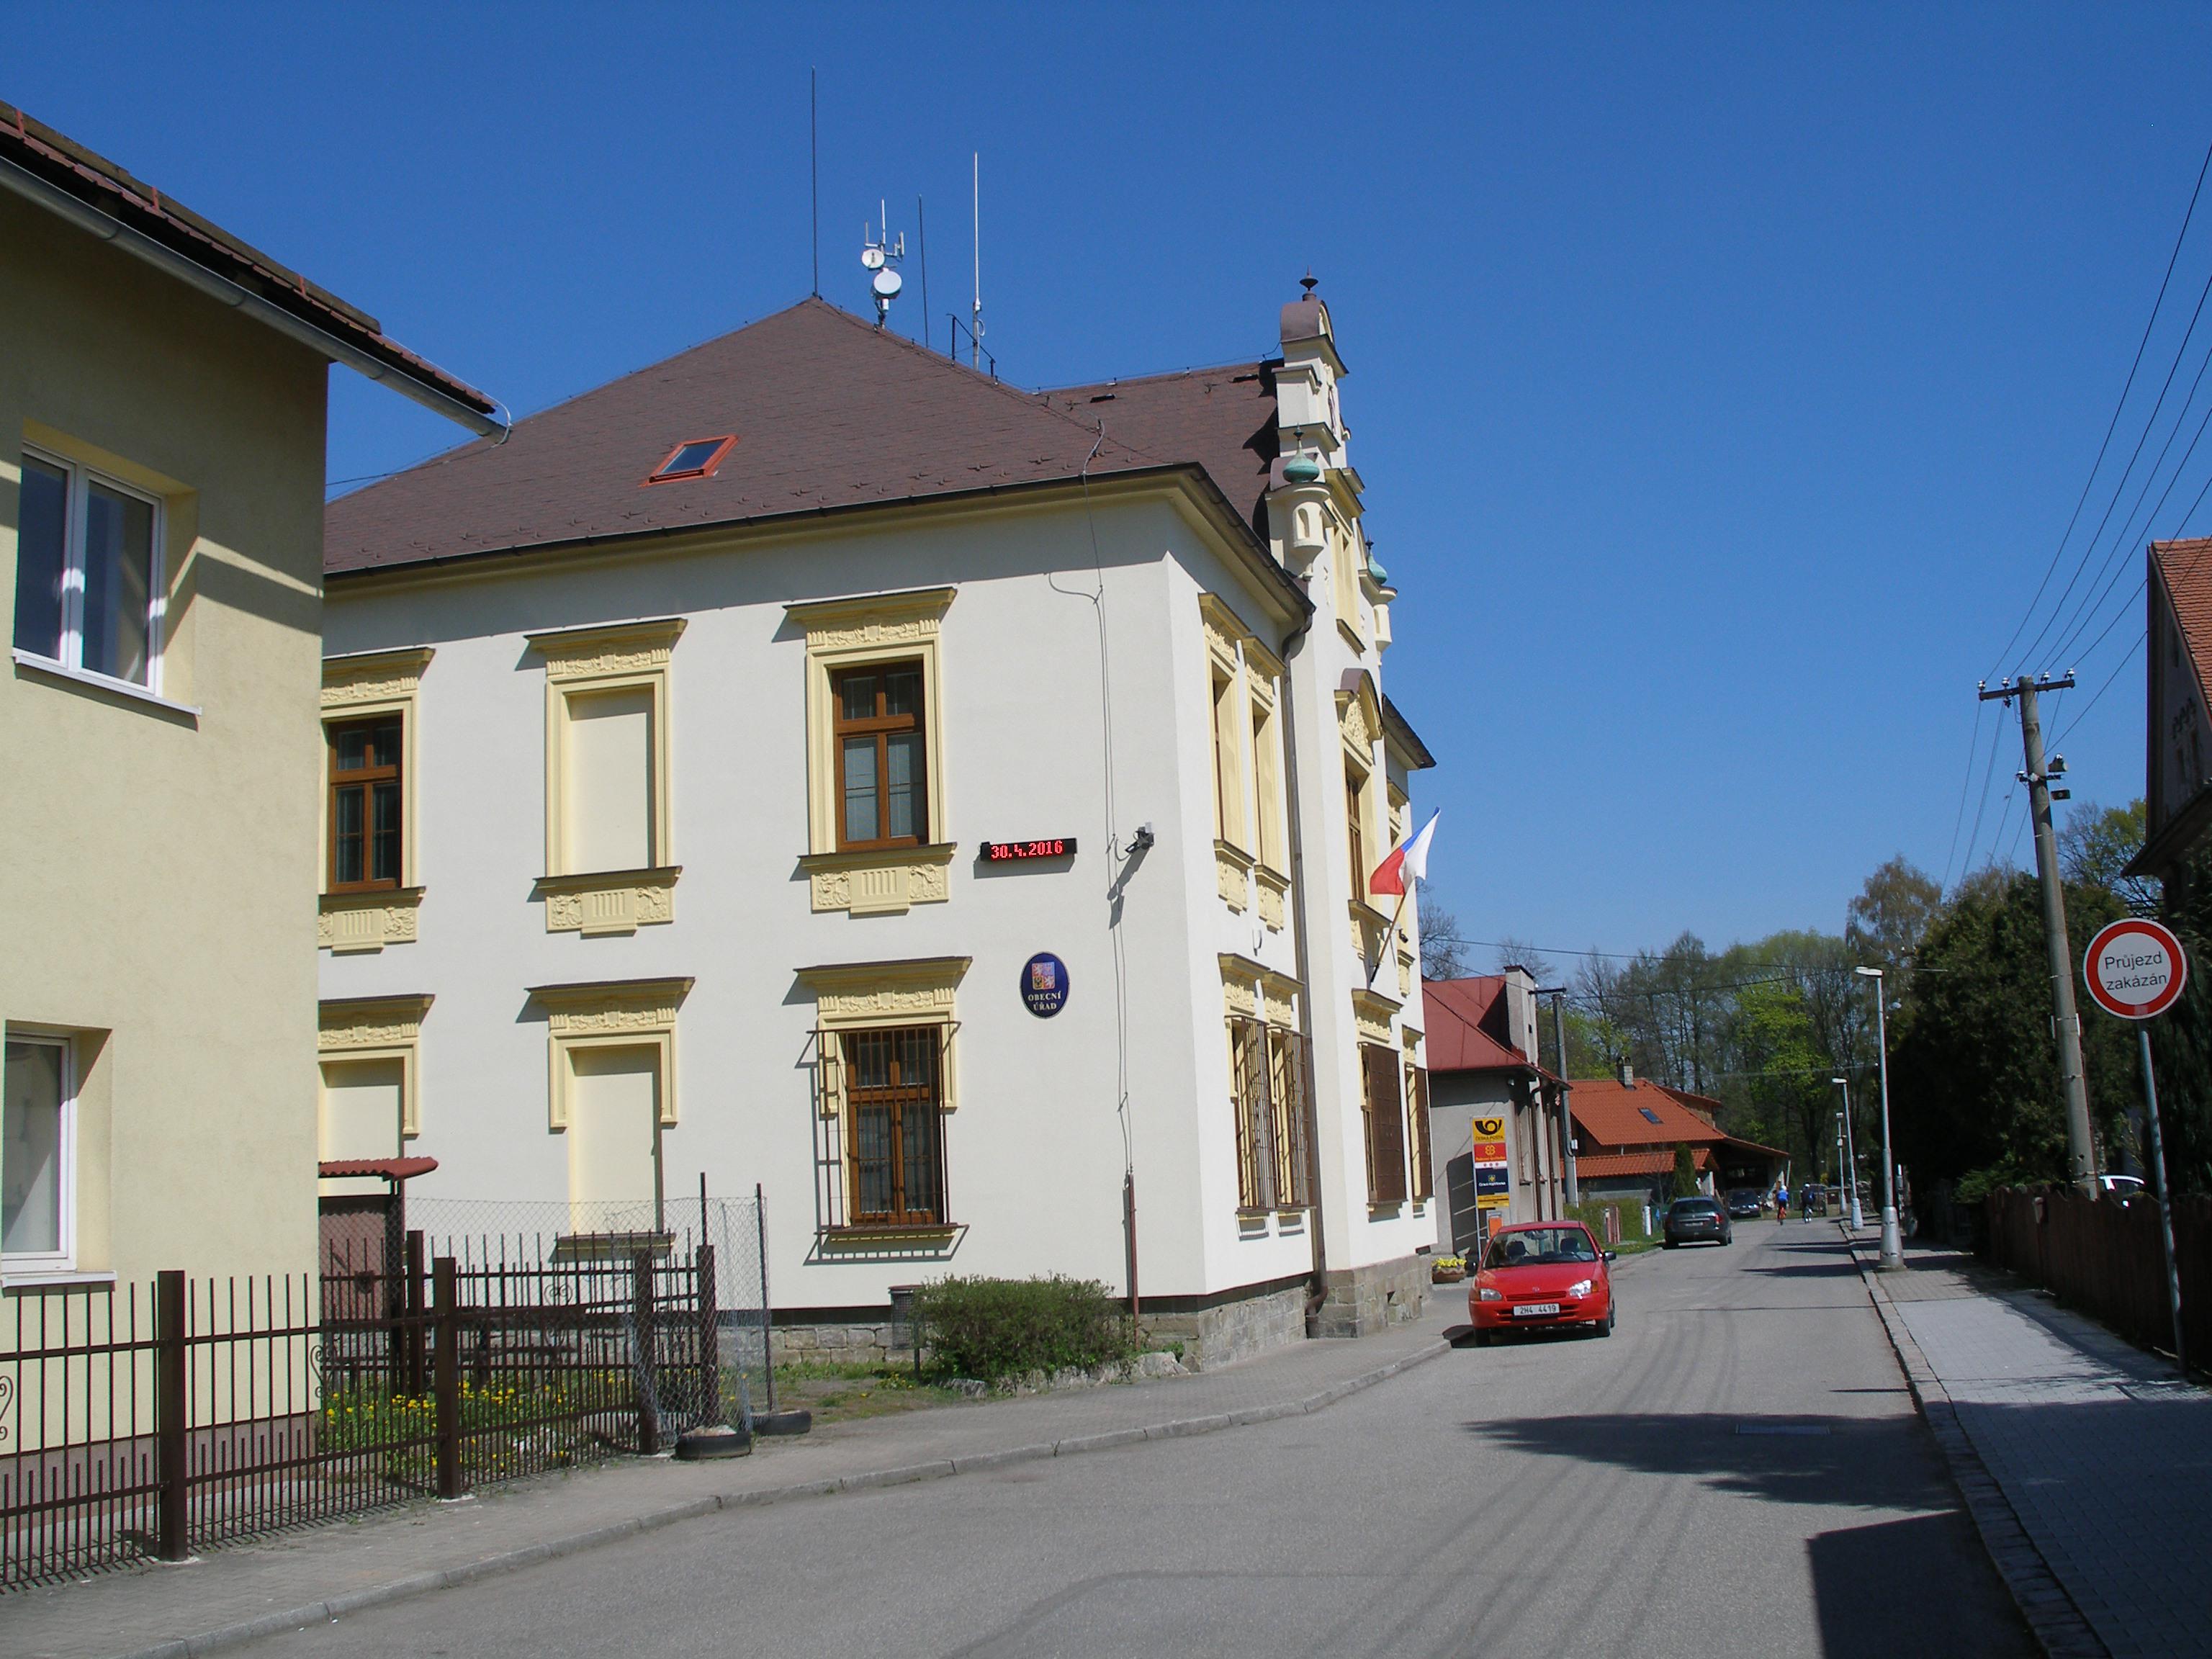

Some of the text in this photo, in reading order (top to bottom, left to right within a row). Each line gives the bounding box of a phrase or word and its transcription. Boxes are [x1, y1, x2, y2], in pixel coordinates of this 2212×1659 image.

[990, 840, 1064, 860] 30.4.2016
[2104, 951, 2162, 970] Průjezd
[2106, 973, 2167, 991] zakázán
[1028, 991, 1061, 1001] OBECNÍ
[1033, 1002, 1056, 1010] ÚŘAD
[1538, 1304, 1557, 1313] 4419
